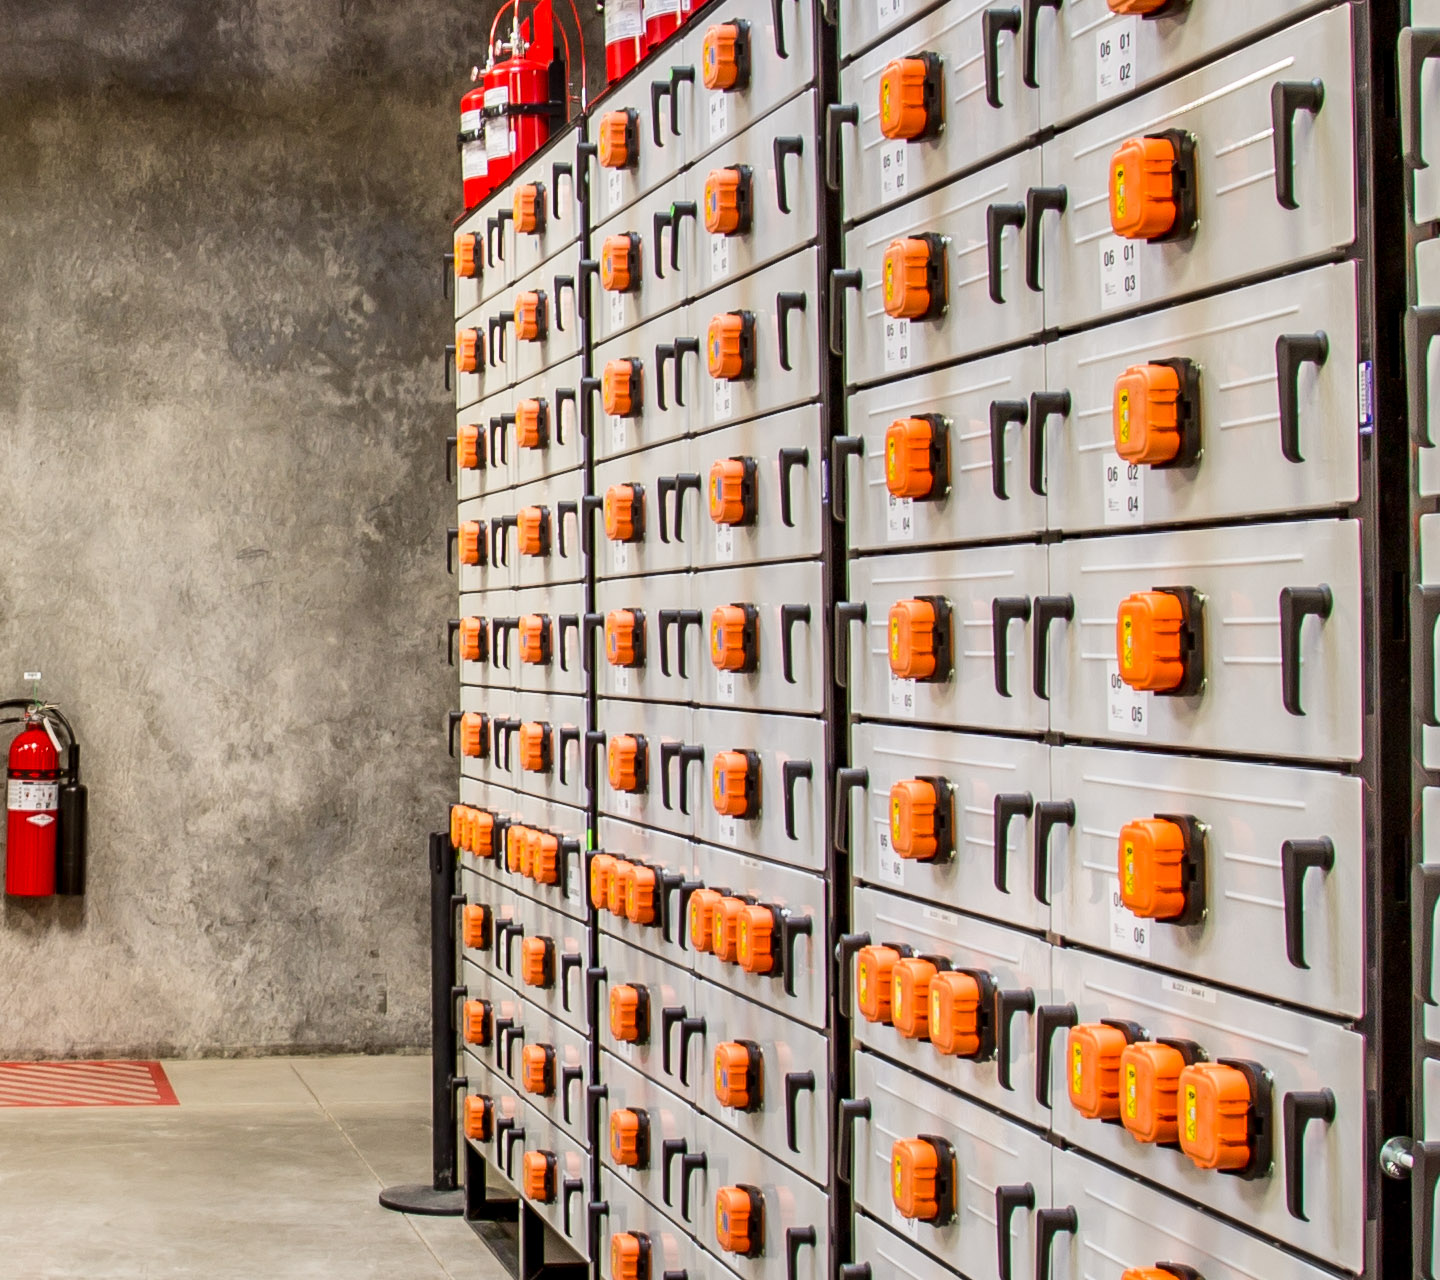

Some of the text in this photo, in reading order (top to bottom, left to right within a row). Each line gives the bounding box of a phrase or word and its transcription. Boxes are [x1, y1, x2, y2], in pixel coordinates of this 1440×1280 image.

[1100, 39, 1111, 58] 06
[1119, 31, 1130, 50] 01
[1119, 62, 1131, 81] 02
